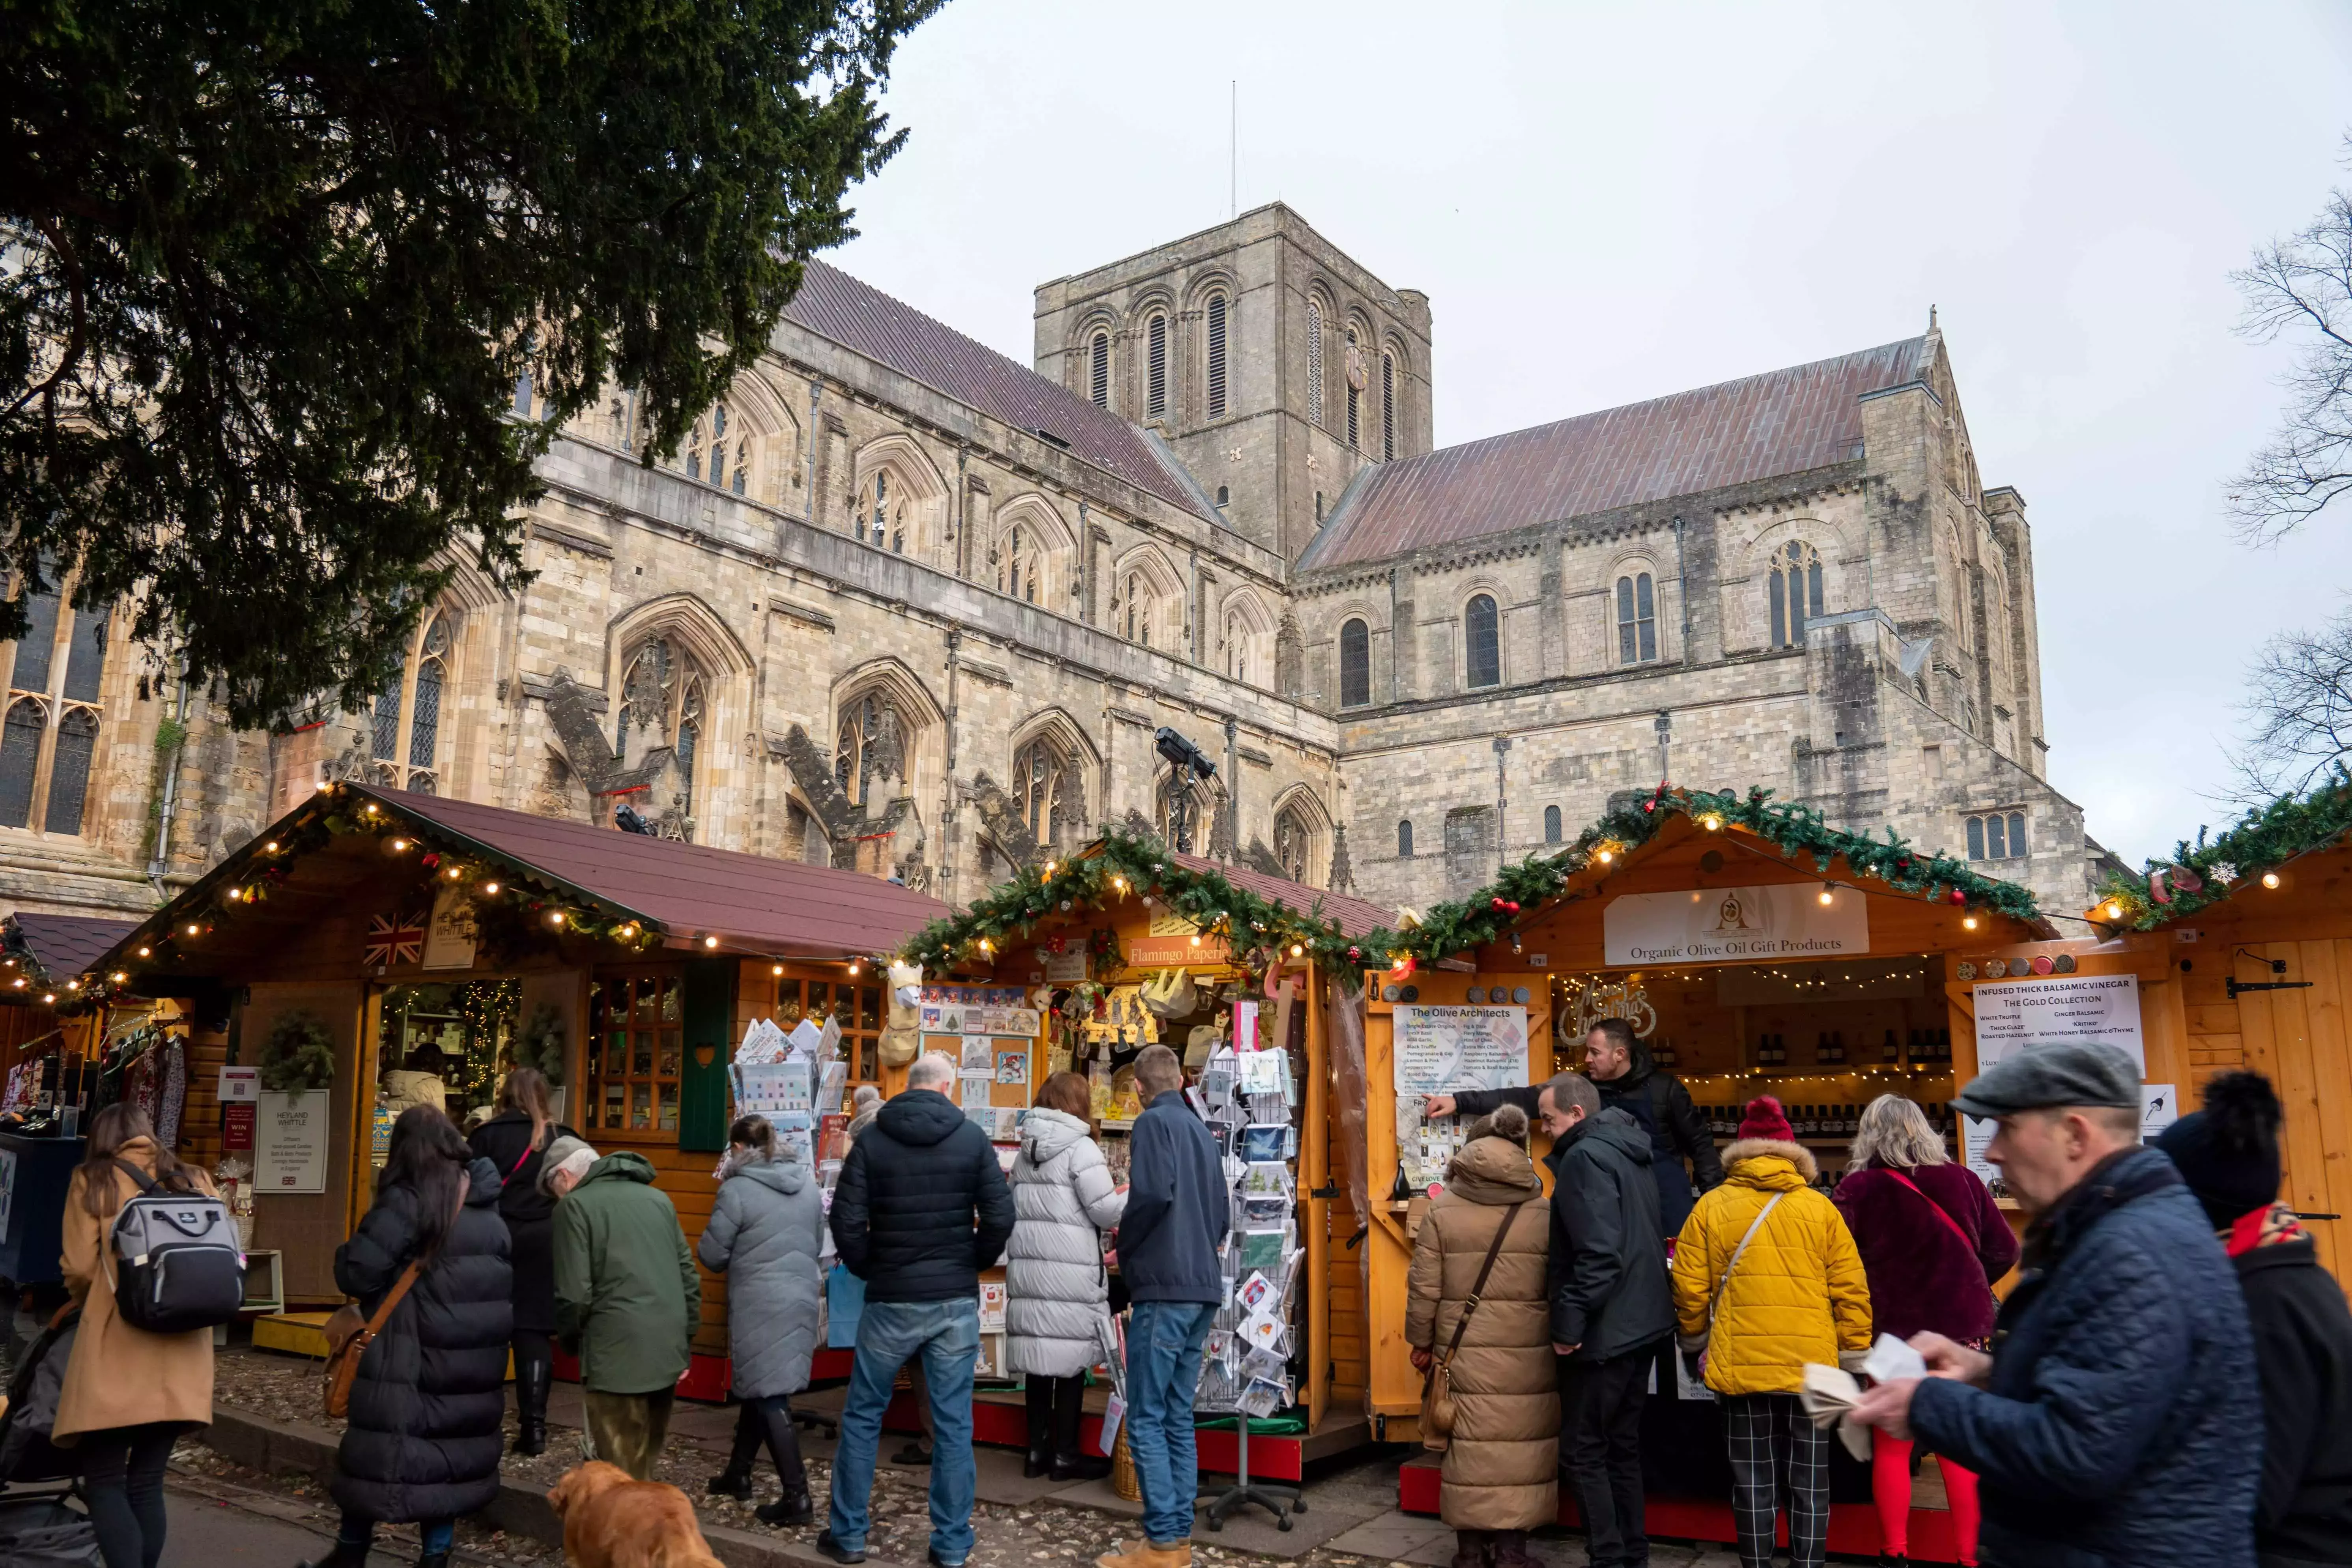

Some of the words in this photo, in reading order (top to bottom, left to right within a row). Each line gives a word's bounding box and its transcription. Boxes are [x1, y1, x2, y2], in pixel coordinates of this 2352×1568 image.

[437, 923, 474, 936] WHITTLE
[1131, 947, 1183, 964] Flamingo
[1187, 945, 1228, 963] Paperie
[1631, 946, 1683, 962] Organic
[1687, 944, 1721, 956] Olive
[1726, 942, 1747, 954] Oil
[1751, 941, 1777, 953] Gift
[1780, 939, 1842, 951] Products
[2044, 983, 2087, 992] BALSAMIC
[1574, 980, 1628, 1013] Merry
[2048, 996, 2101, 1005] COLLECTION
[1411, 1008, 1430, 1017] The
[1432, 1008, 1457, 1017] Olive
[1460, 1009, 1510, 1017] Architects
